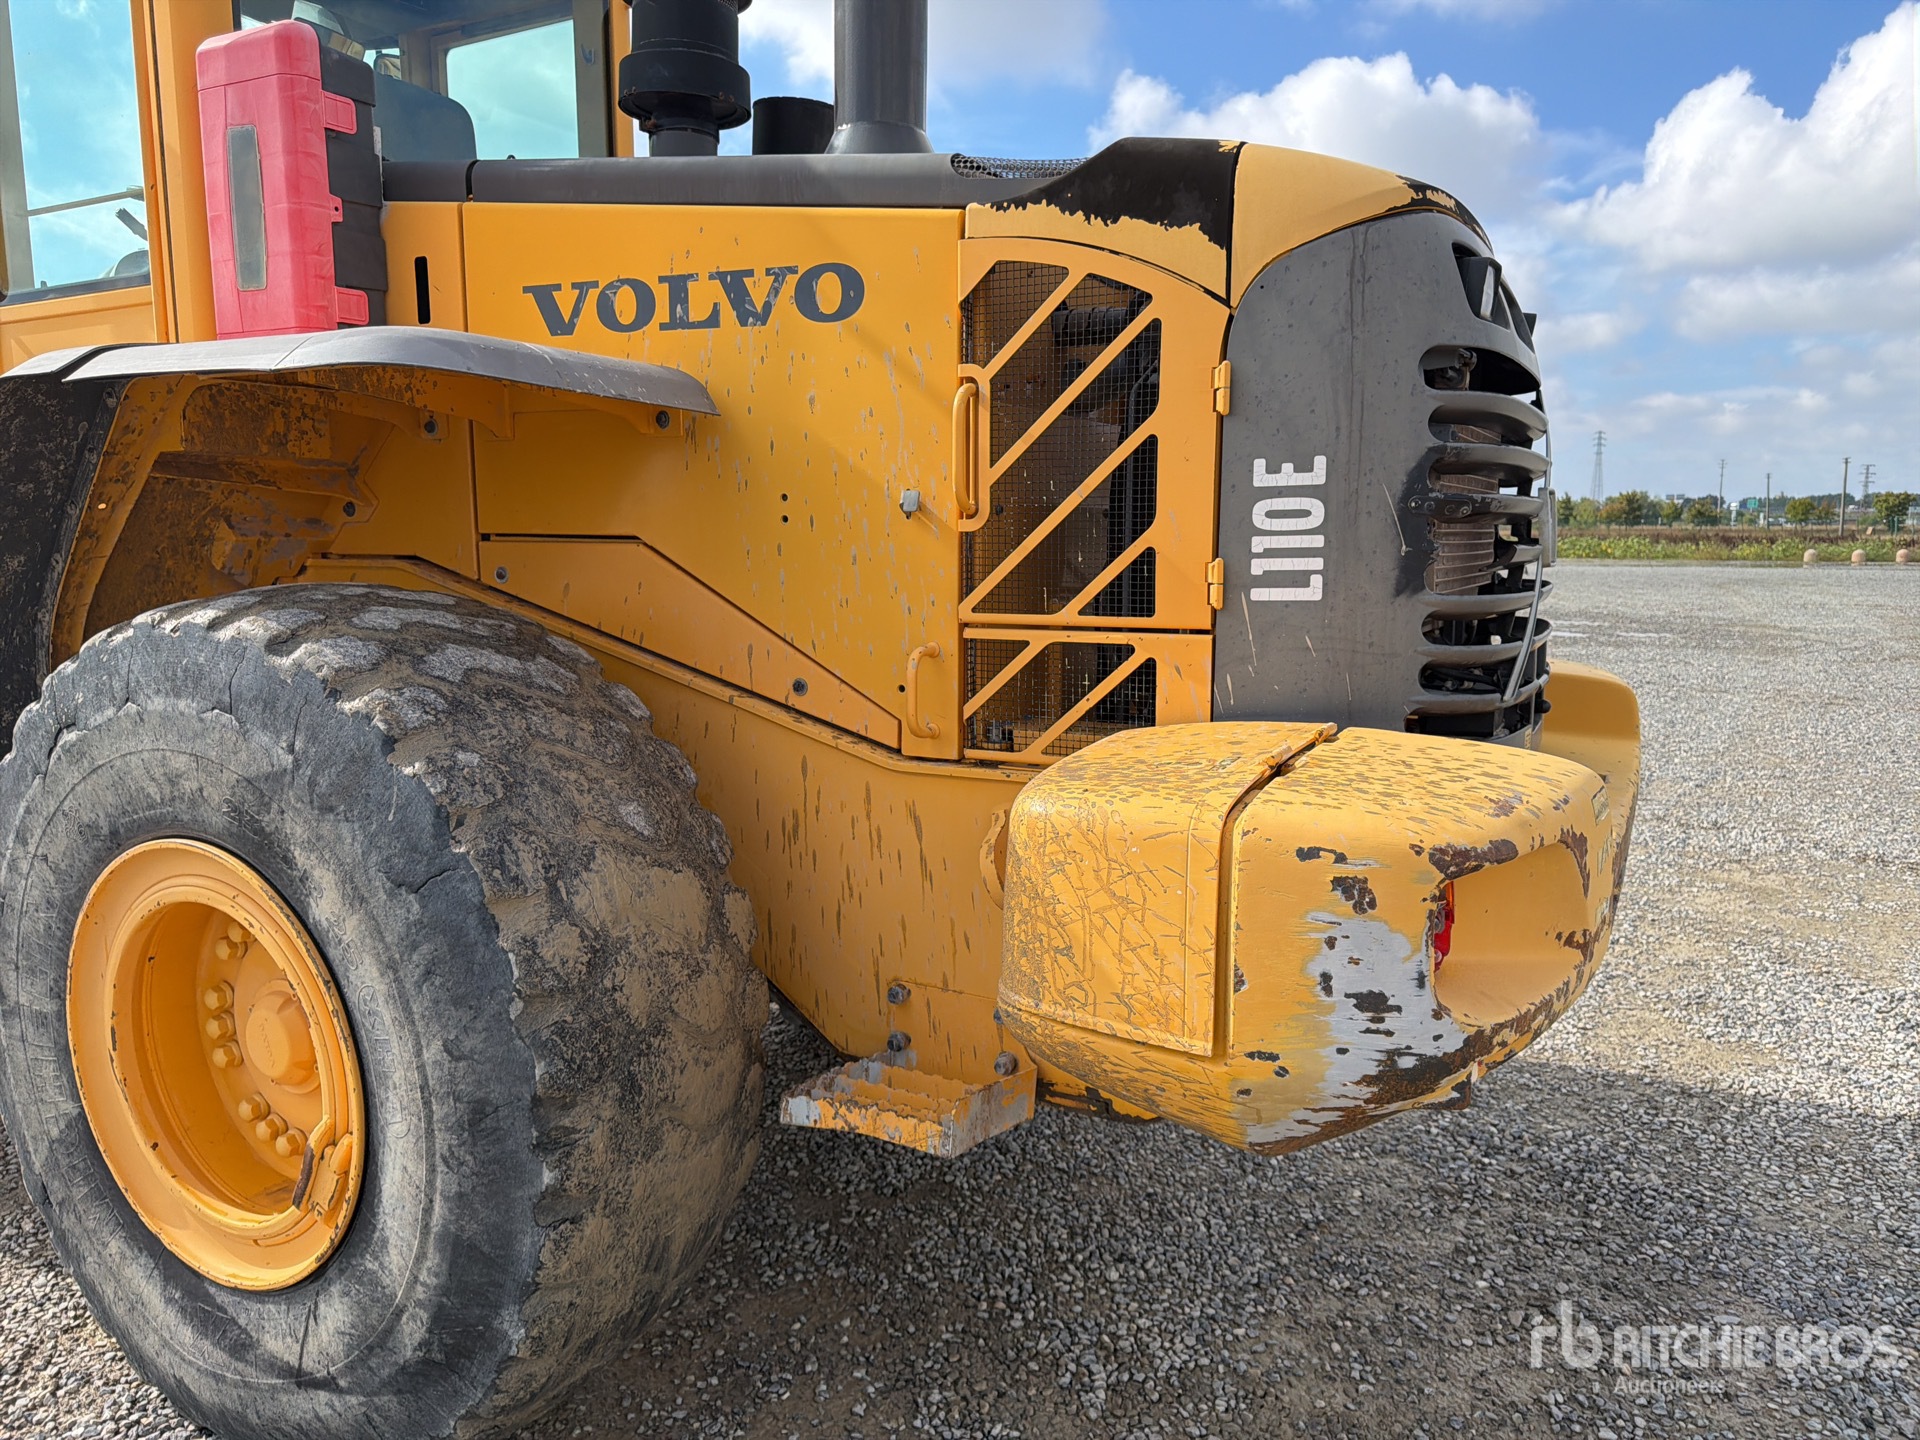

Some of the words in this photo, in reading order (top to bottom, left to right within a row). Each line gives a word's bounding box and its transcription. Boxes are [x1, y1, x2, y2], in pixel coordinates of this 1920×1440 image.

[522, 262, 865, 337] VOLVO
[1250, 455, 1327, 601] L110E
[325, 910, 364, 970] 25
